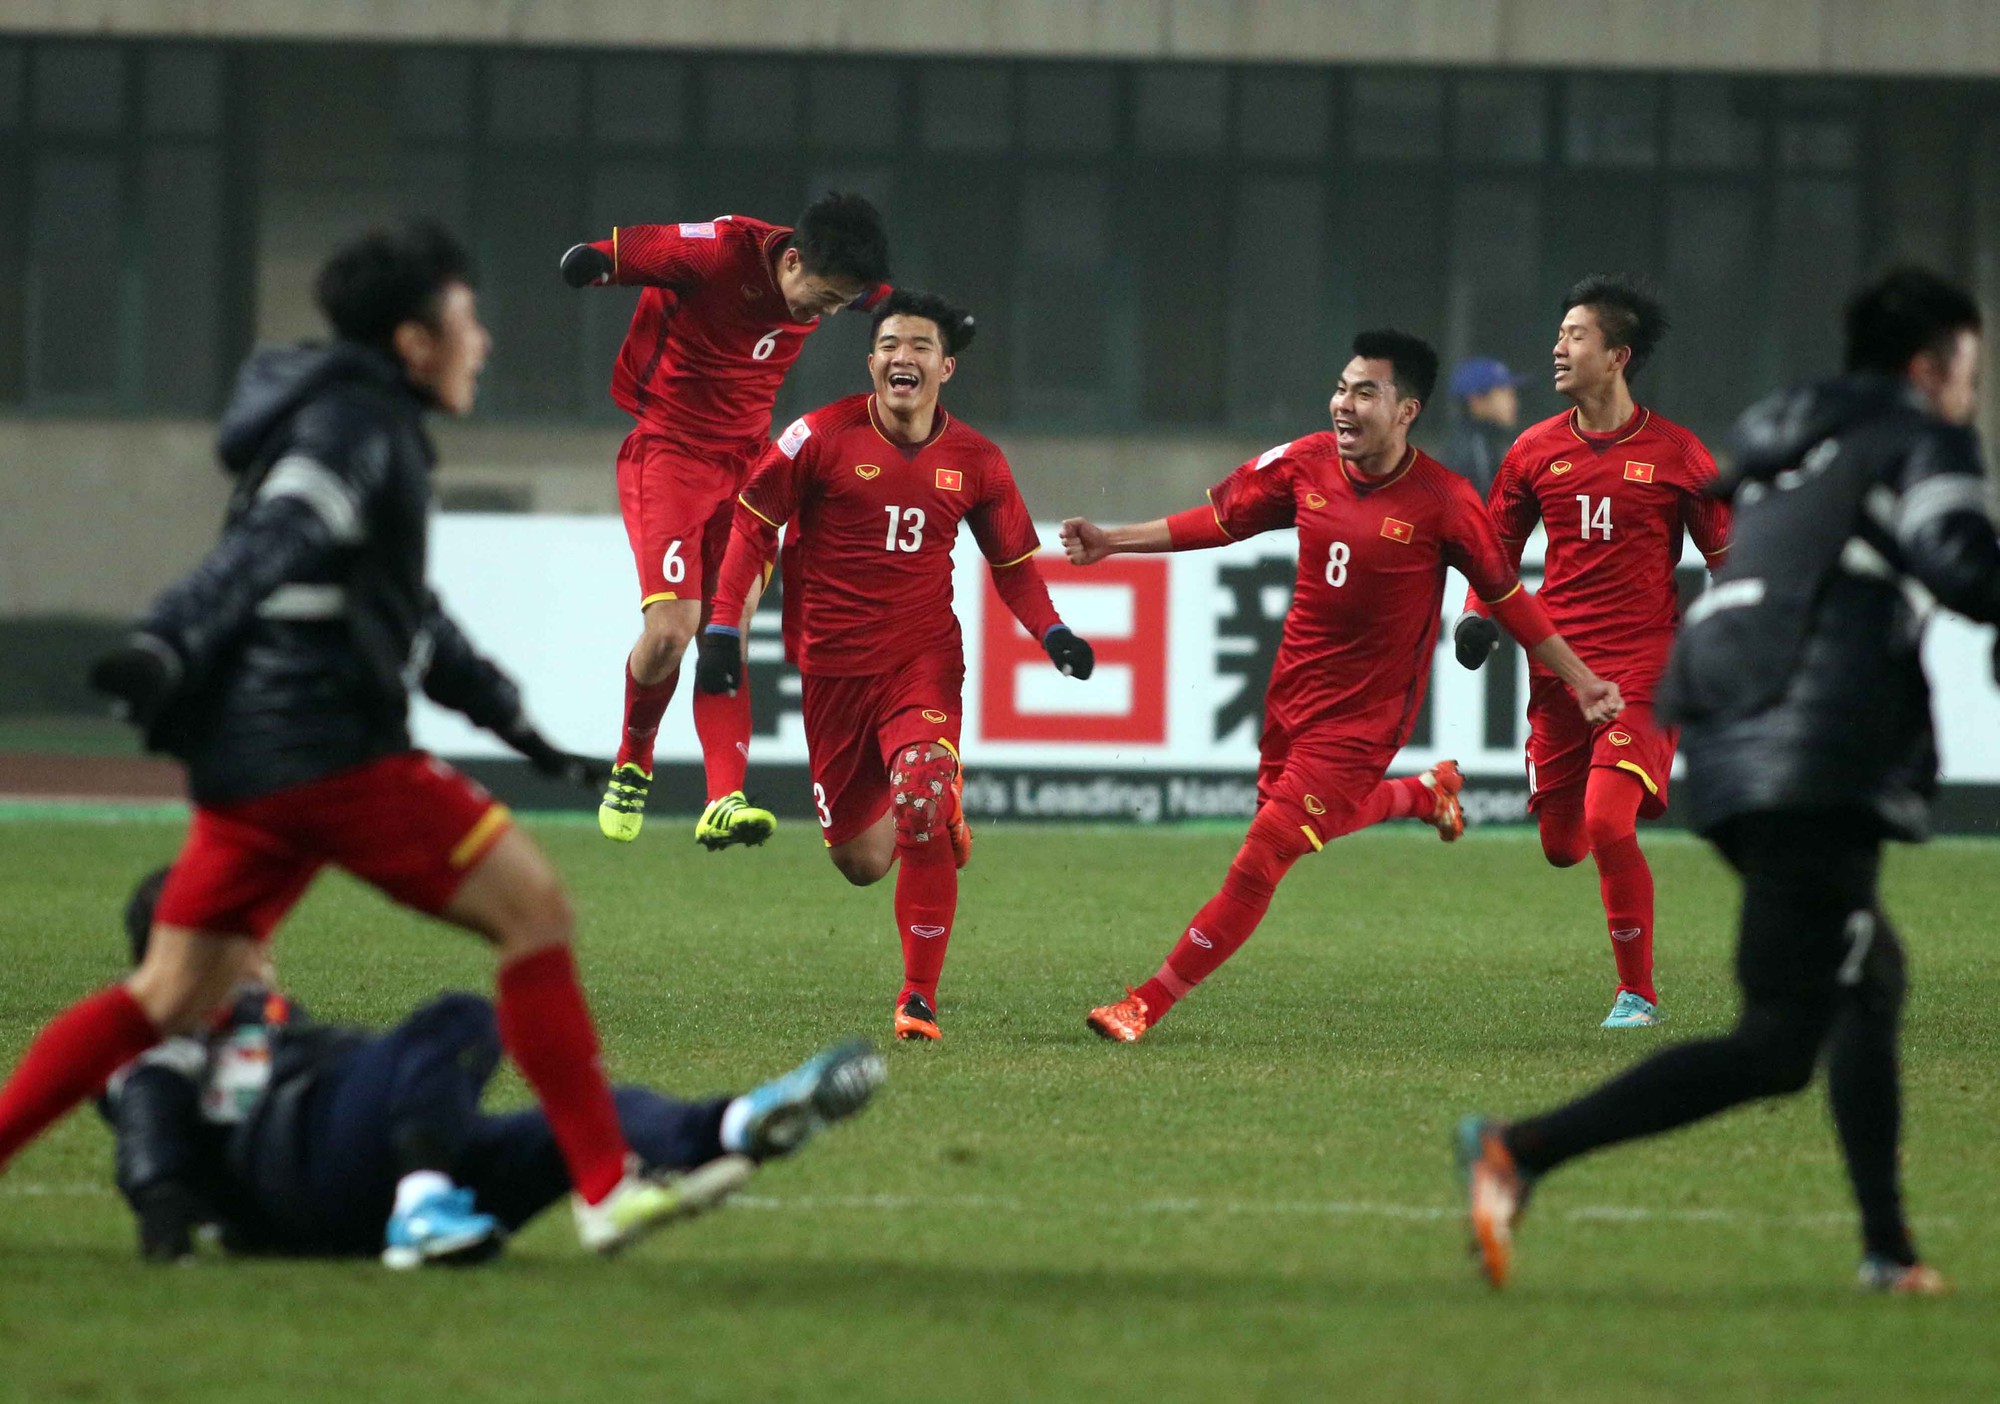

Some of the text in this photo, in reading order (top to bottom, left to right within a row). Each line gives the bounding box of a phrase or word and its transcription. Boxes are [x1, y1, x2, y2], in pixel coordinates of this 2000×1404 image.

[752, 329, 783, 361] 6
[884, 505, 926, 553] 13
[1575, 494, 1614, 541] 14
[662, 540, 686, 584] 6
[1325, 541, 1351, 588] 8
[1014, 773, 1162, 824] Leading
